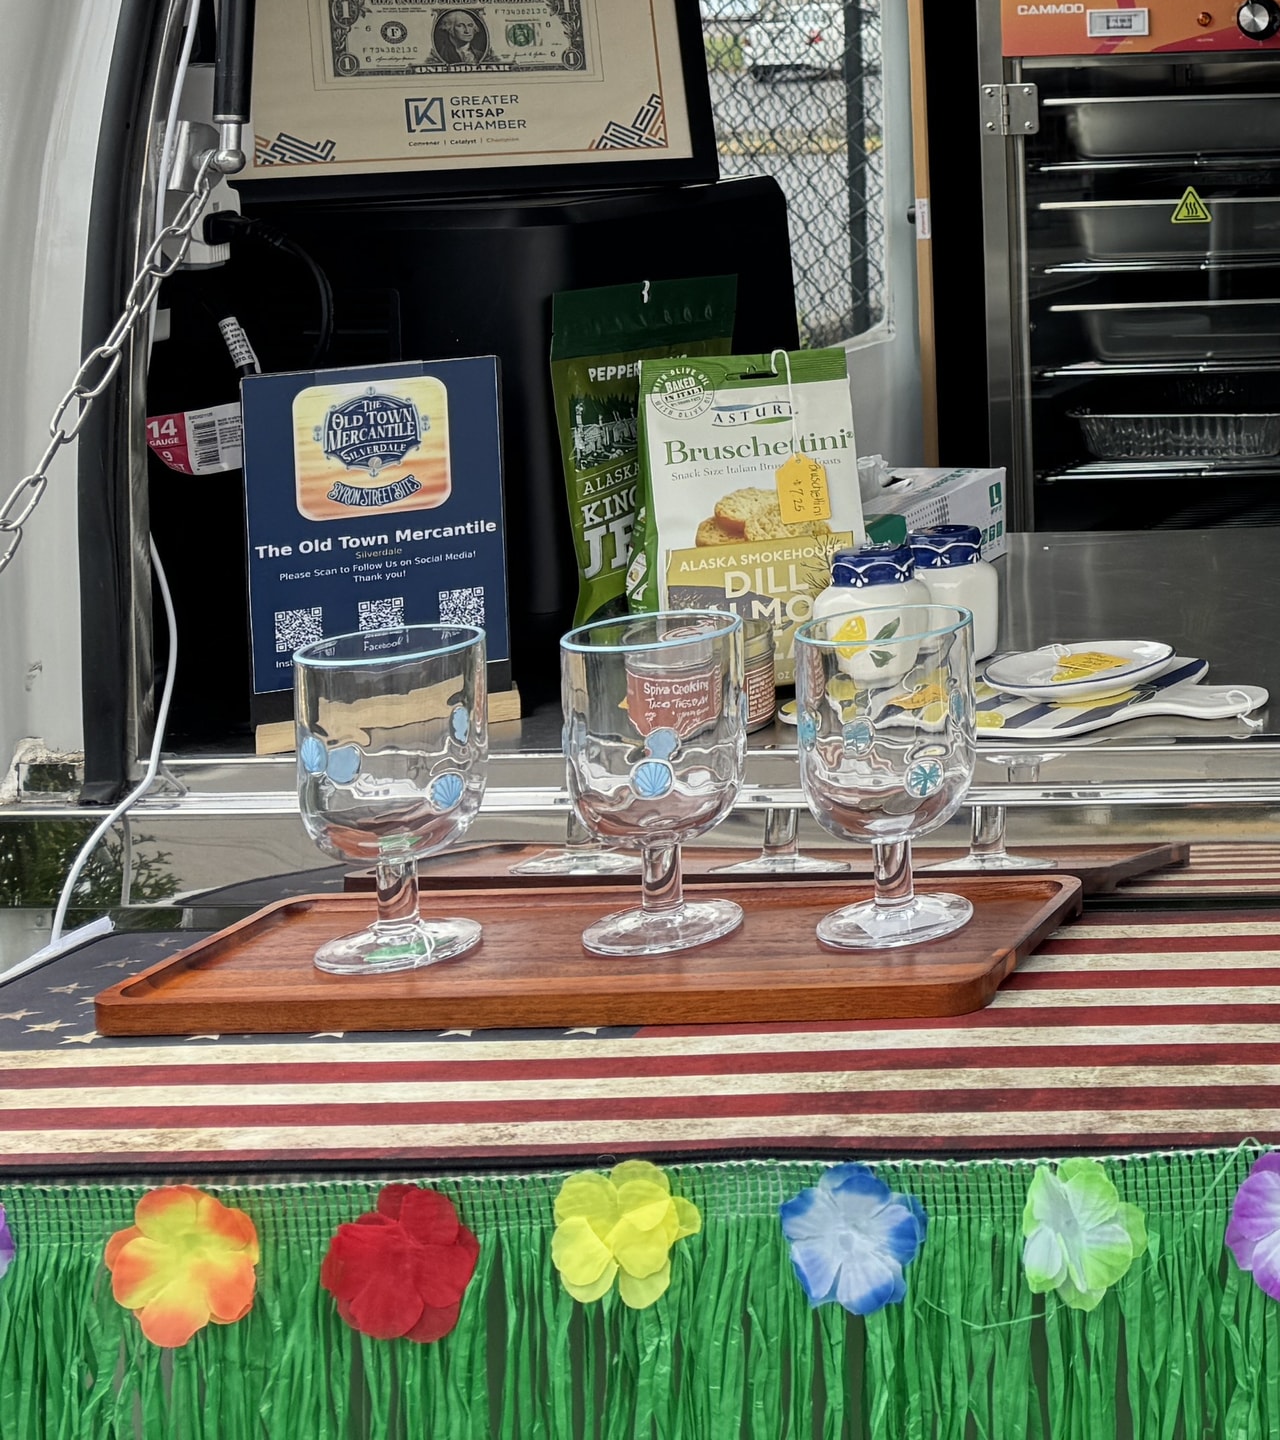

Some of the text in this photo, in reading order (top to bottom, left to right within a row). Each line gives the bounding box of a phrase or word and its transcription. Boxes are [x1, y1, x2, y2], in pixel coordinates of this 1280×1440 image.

[450, 94, 519, 106] GREATER
[451, 108, 504, 119] KITSAP
[452, 119, 527, 131] CHAMBER
[665, 376, 696, 394] BAKED
[362, 400, 381, 411] THE
[332, 408, 412, 430] OLD TOWN
[146, 418, 178, 439] 14
[329, 421, 415, 452] MERCANTILE
[149, 438, 179, 447] GAUGE
[341, 444, 406, 462] SILVERDALE
[671, 462, 757, 481] Snack Size Italian
[328, 475, 421, 506] BYRON STREET BITES
[254, 520, 497, 559] The Old Town Mercantile
[355, 547, 403, 559] Silverdale
[279, 550, 477, 582] Please Scan to Follow Us on Social Media!
[680, 556, 737, 573] ALASKA
[353, 570, 406, 582] Thank you!
[724, 564, 810, 599] DILL
